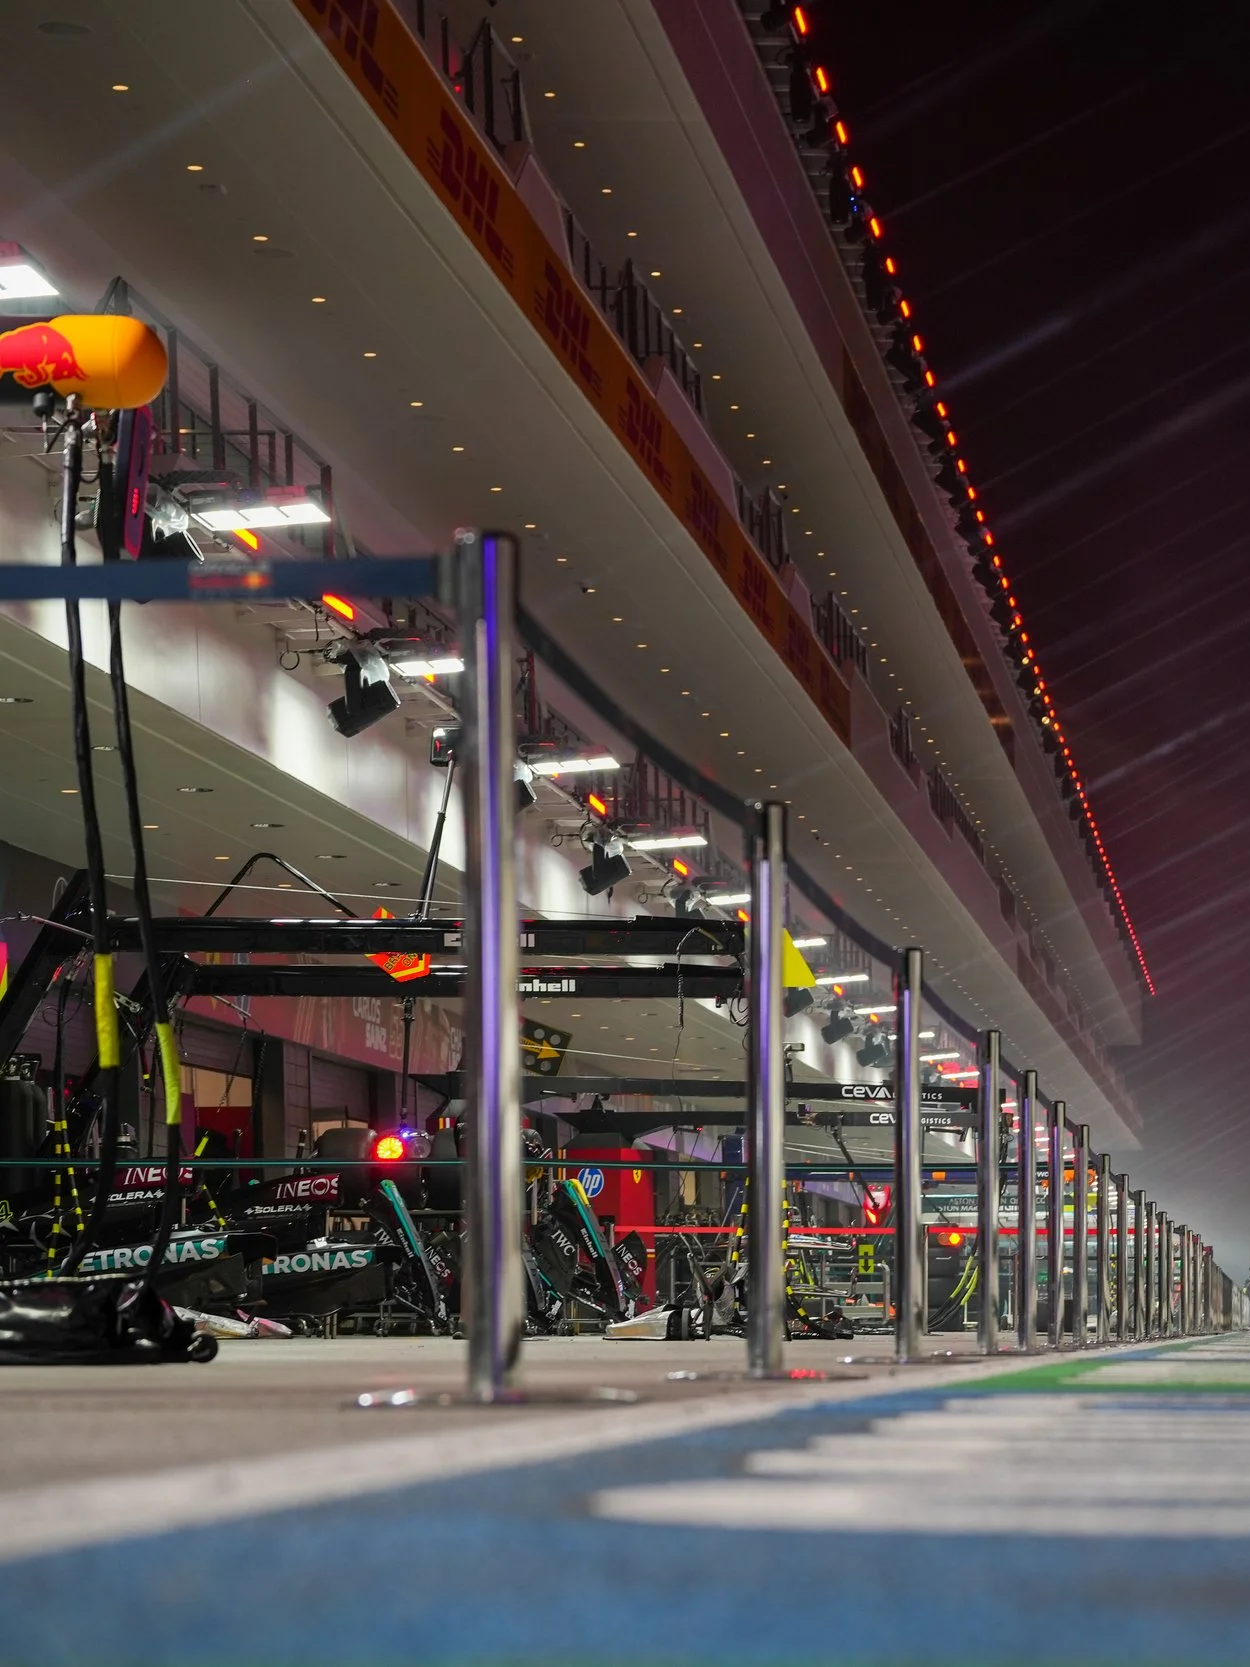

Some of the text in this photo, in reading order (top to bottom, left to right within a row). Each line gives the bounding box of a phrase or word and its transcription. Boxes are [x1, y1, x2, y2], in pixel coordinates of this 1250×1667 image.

[438, 107, 503, 263] DHL
[545, 258, 593, 387] DHL
[626, 376, 665, 484] DHL
[515, 979, 576, 992] nhell
[921, 1117, 951, 1125] GISTICS
[108, 1191, 154, 1202] OLERA
[254, 1203, 302, 1214] SOLERA
[78, 1238, 221, 1273] ETRONAS
[551, 1229, 576, 1256] IWC
[580, 1227, 599, 1258] Einhell
[424, 1245, 451, 1278] INEOS
[615, 1243, 643, 1276] INEOS
